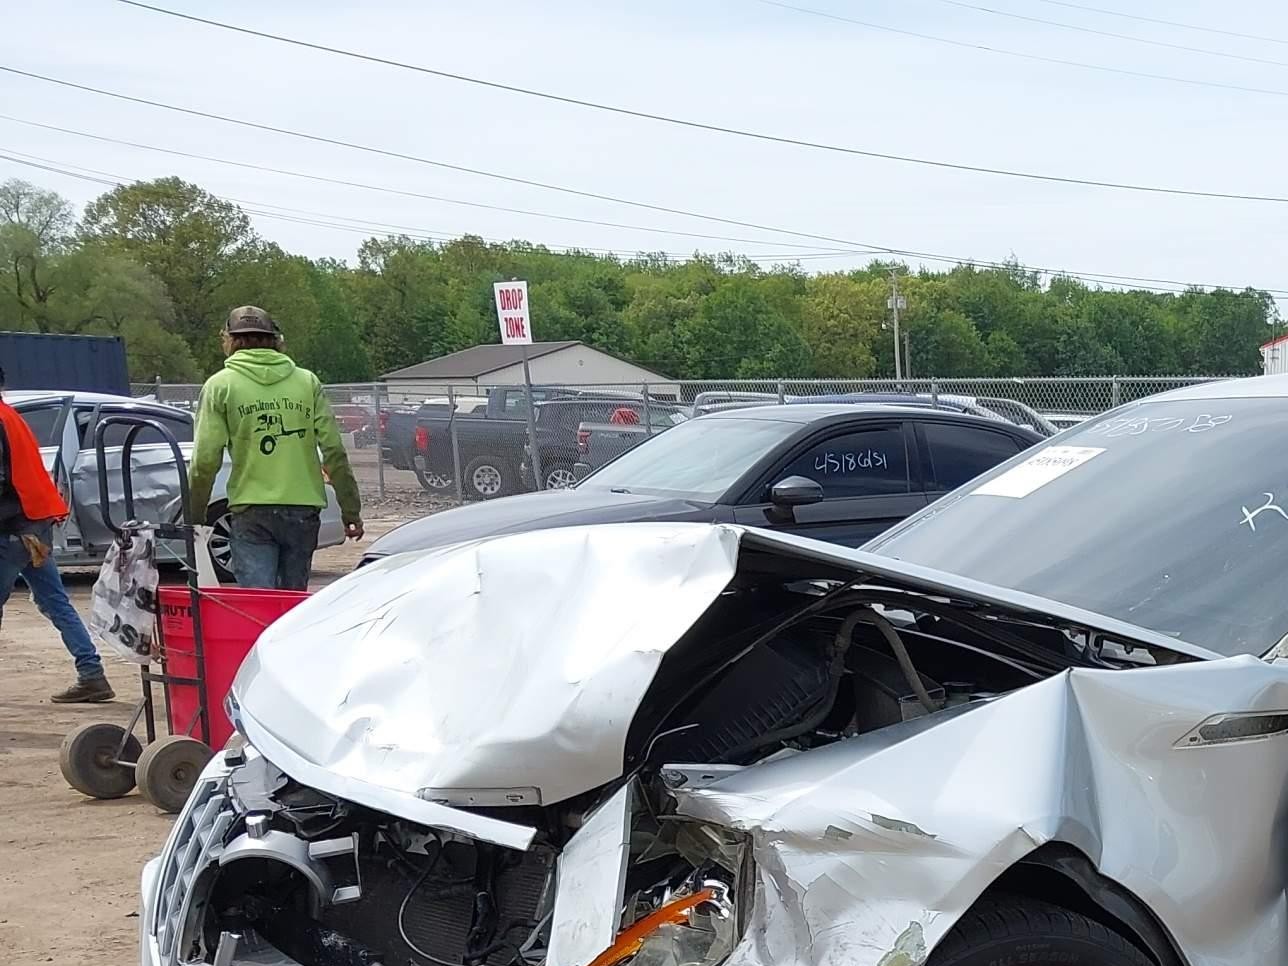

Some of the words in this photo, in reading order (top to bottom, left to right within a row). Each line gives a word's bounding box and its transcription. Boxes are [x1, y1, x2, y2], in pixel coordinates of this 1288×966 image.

[499, 288, 524, 311] DROP
[504, 317, 526, 338] ZONE
[161, 604, 193, 617] RUT
